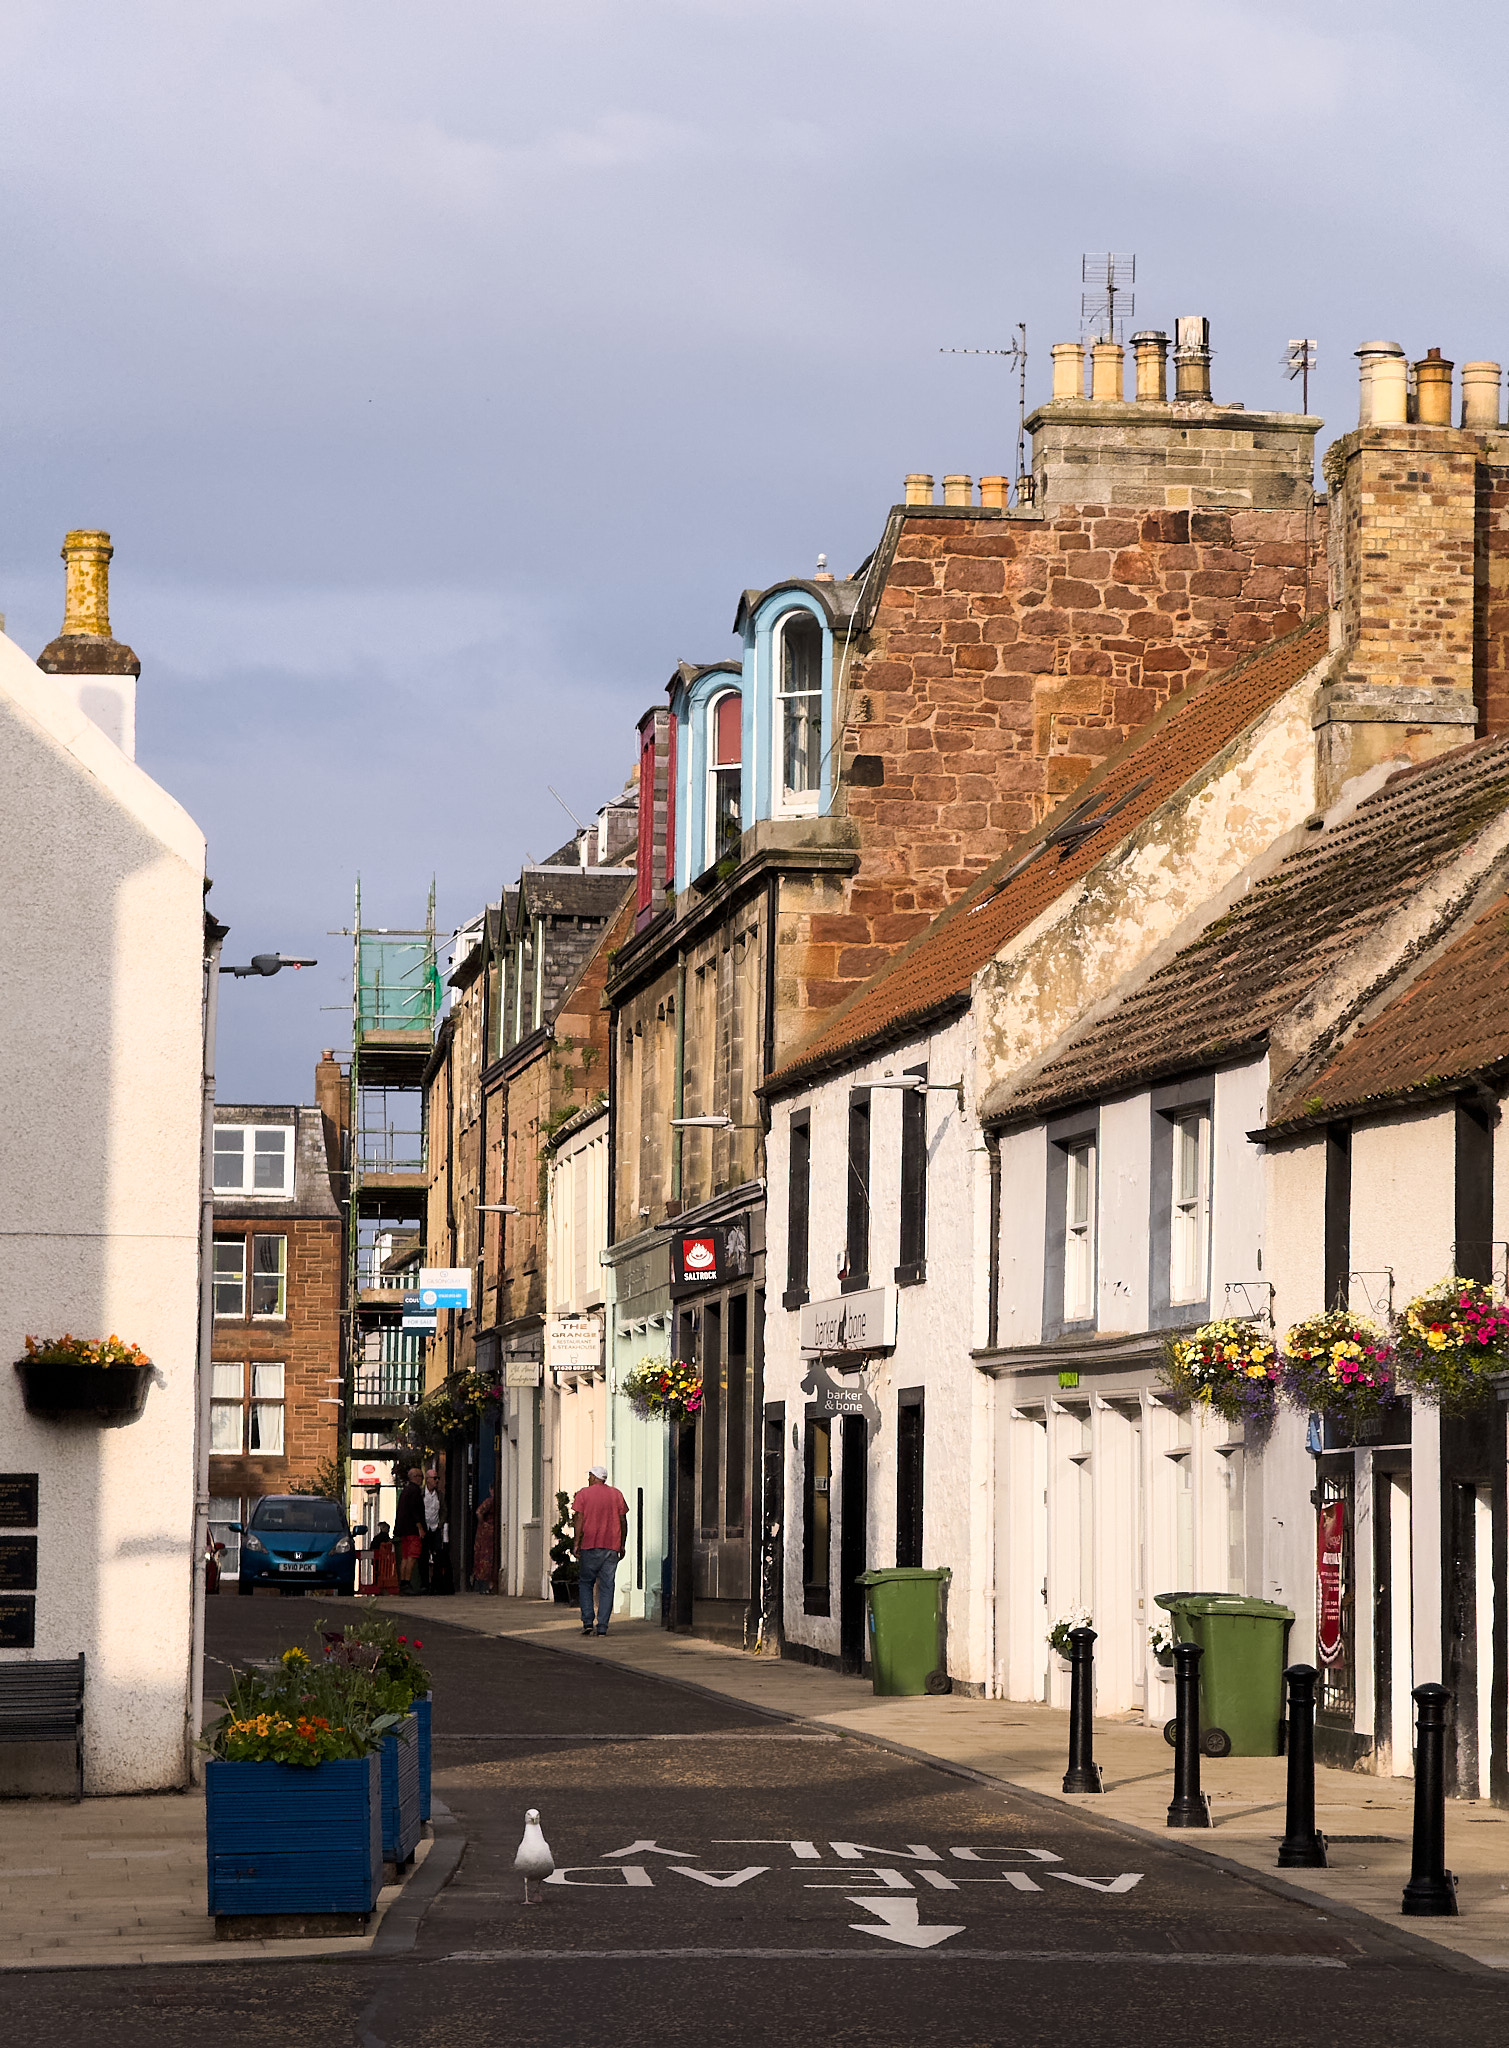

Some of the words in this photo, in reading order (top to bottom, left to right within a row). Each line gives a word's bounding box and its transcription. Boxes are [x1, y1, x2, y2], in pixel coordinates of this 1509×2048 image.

[684, 1270, 717, 1281] SALTROCK
[815, 1310, 838, 1346] barker
[848, 1305, 867, 1339] bone
[827, 1389, 863, 1401] barker
[824, 1400, 834, 1410] &
[836, 1401, 863, 1412] bone
[600, 1838, 1064, 1864] ONLY
[542, 1864, 1145, 1894] AHEAD
